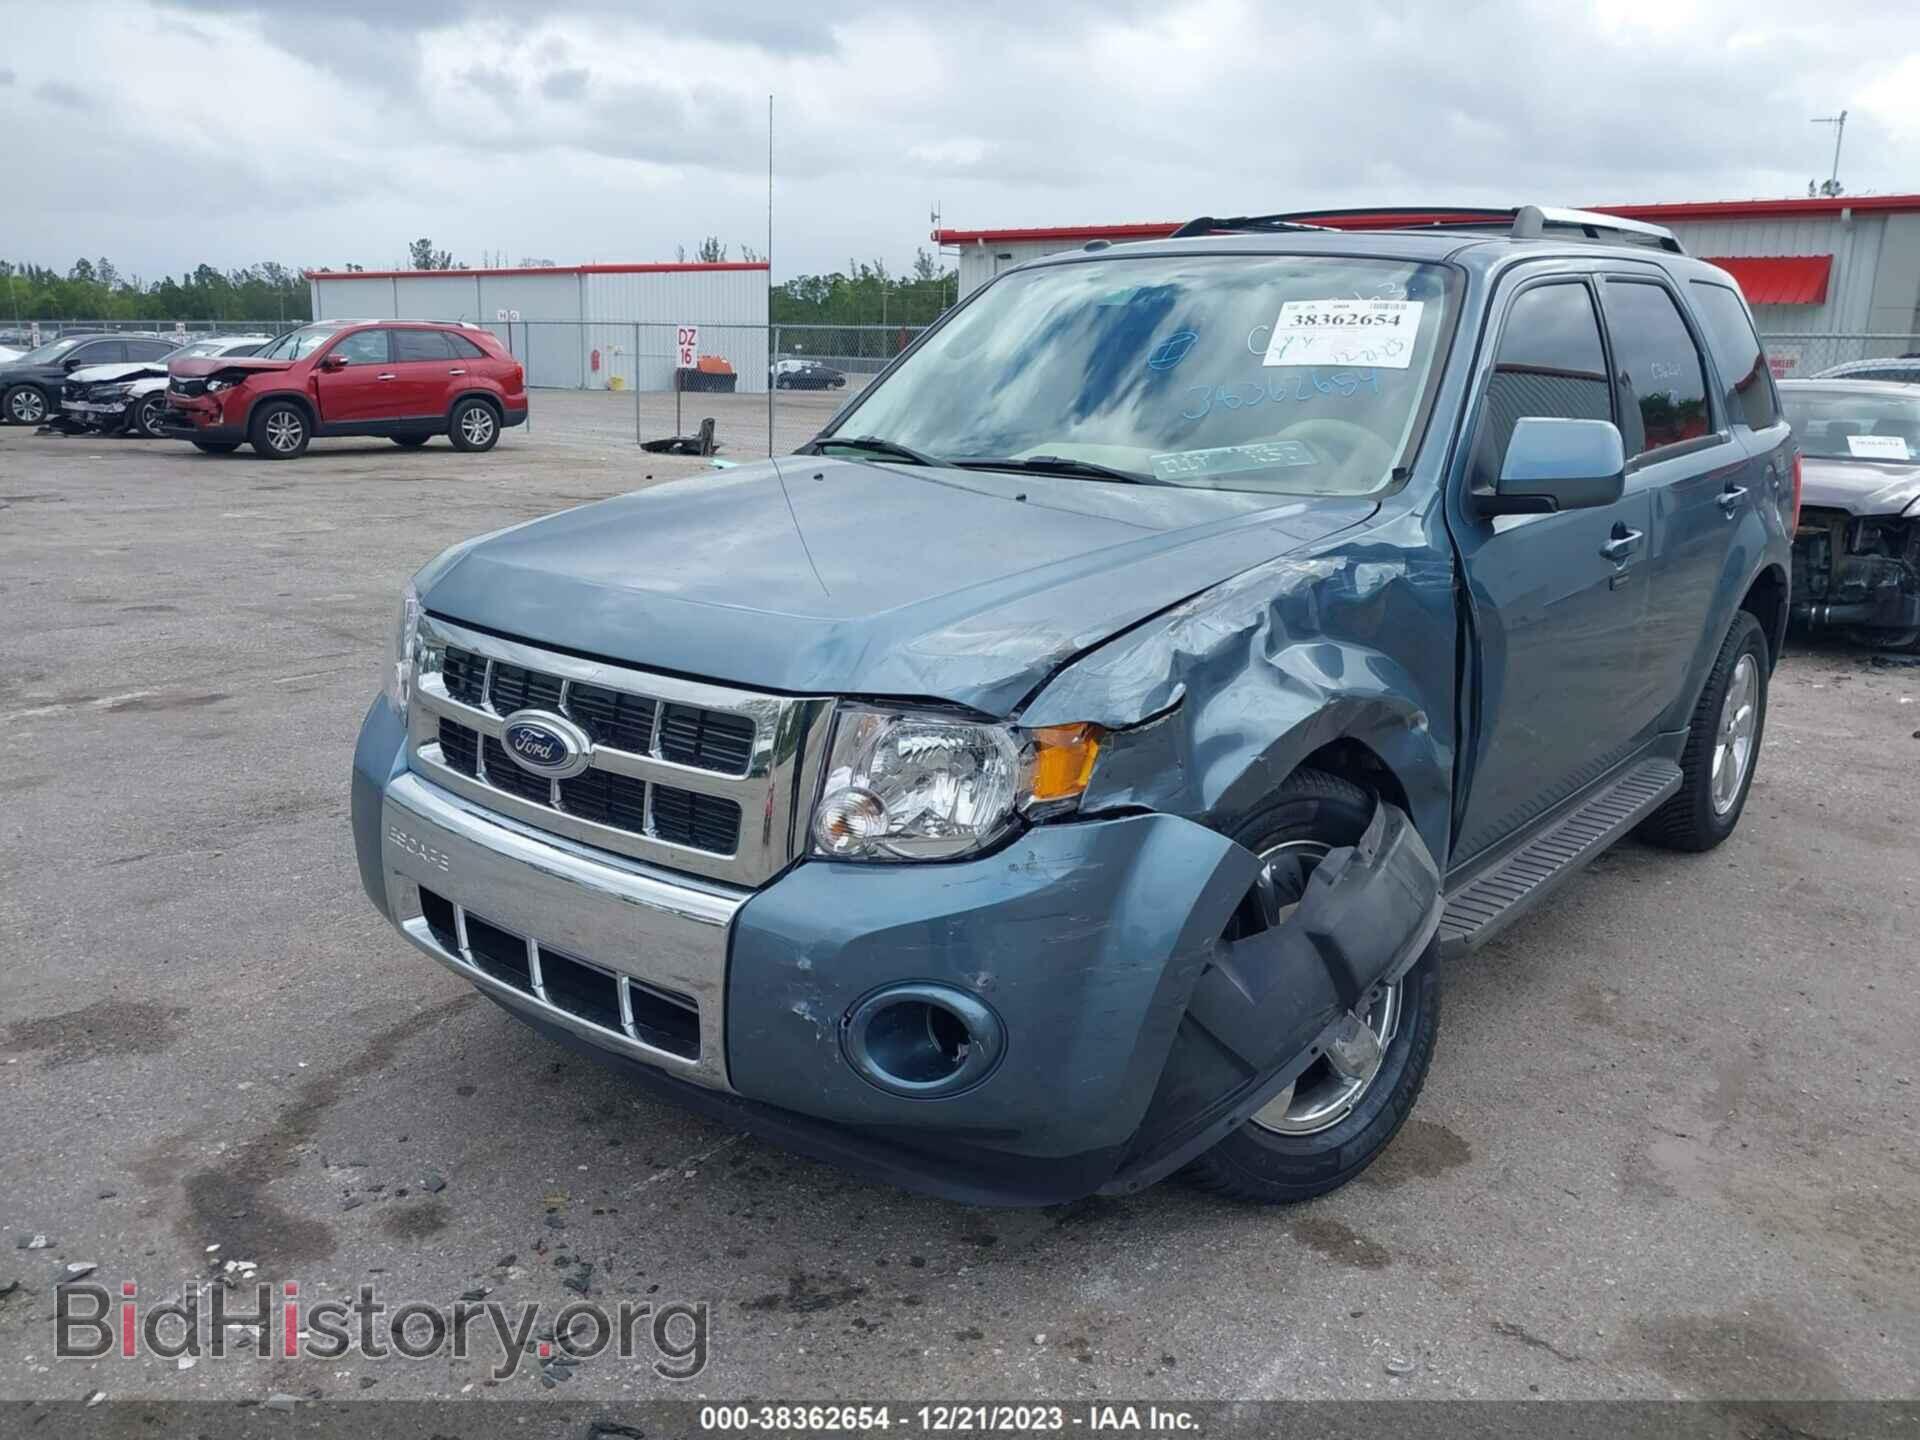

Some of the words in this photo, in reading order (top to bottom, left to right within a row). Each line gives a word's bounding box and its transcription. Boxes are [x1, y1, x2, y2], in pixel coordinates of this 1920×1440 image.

[1289, 313, 1401, 327] 38362654
[678, 328, 697, 346] DZ
[681, 348, 692, 365] 16
[514, 728, 555, 759] Ford
